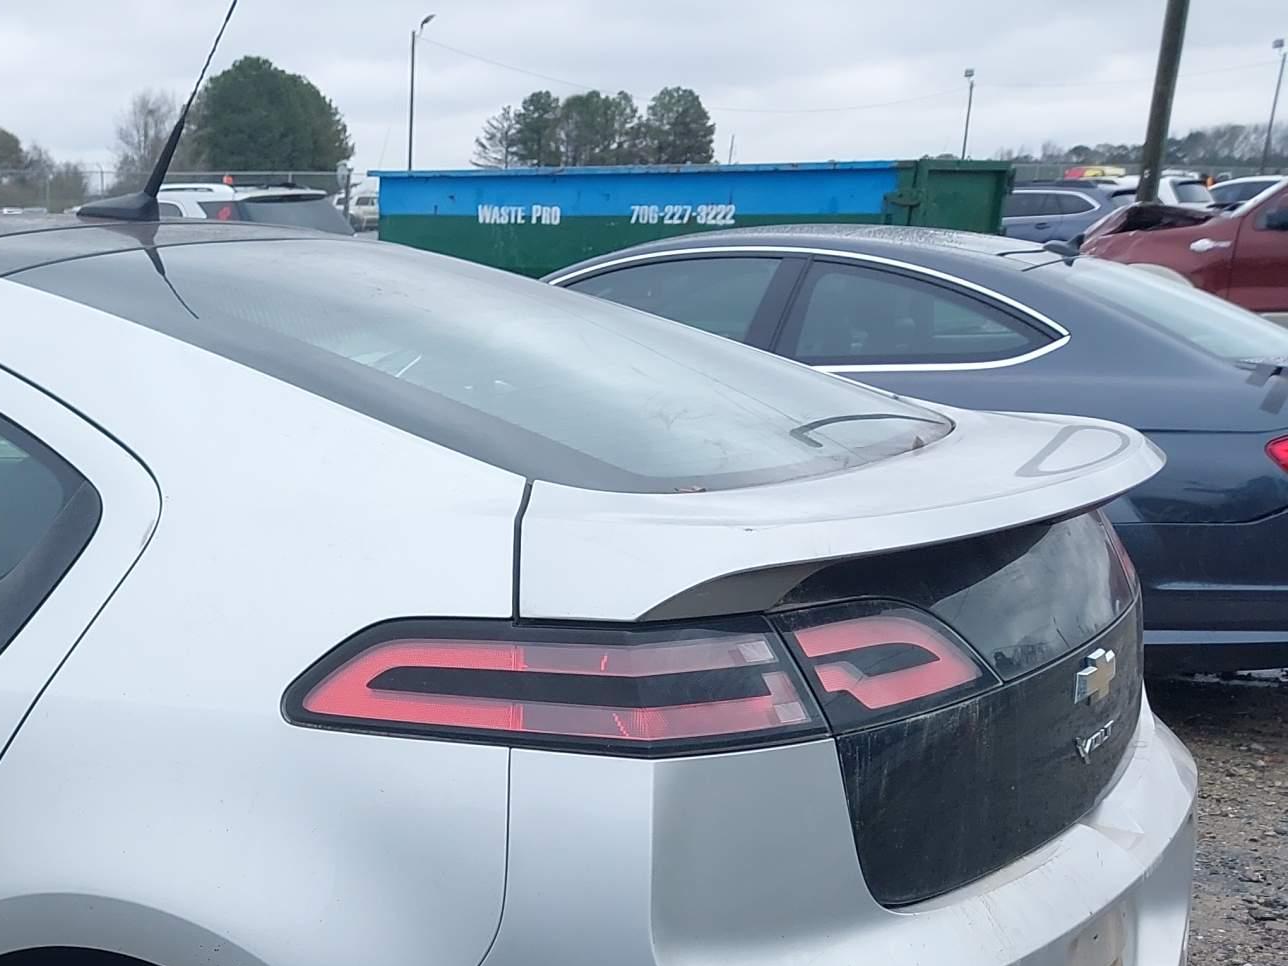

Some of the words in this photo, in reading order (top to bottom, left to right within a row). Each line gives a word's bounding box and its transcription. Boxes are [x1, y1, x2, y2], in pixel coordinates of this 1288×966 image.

[478, 204, 526, 224] WASTE
[531, 205, 561, 225] PRO
[630, 204, 736, 225] 706-227-3222
[1075, 720, 1114, 764] VOLT
